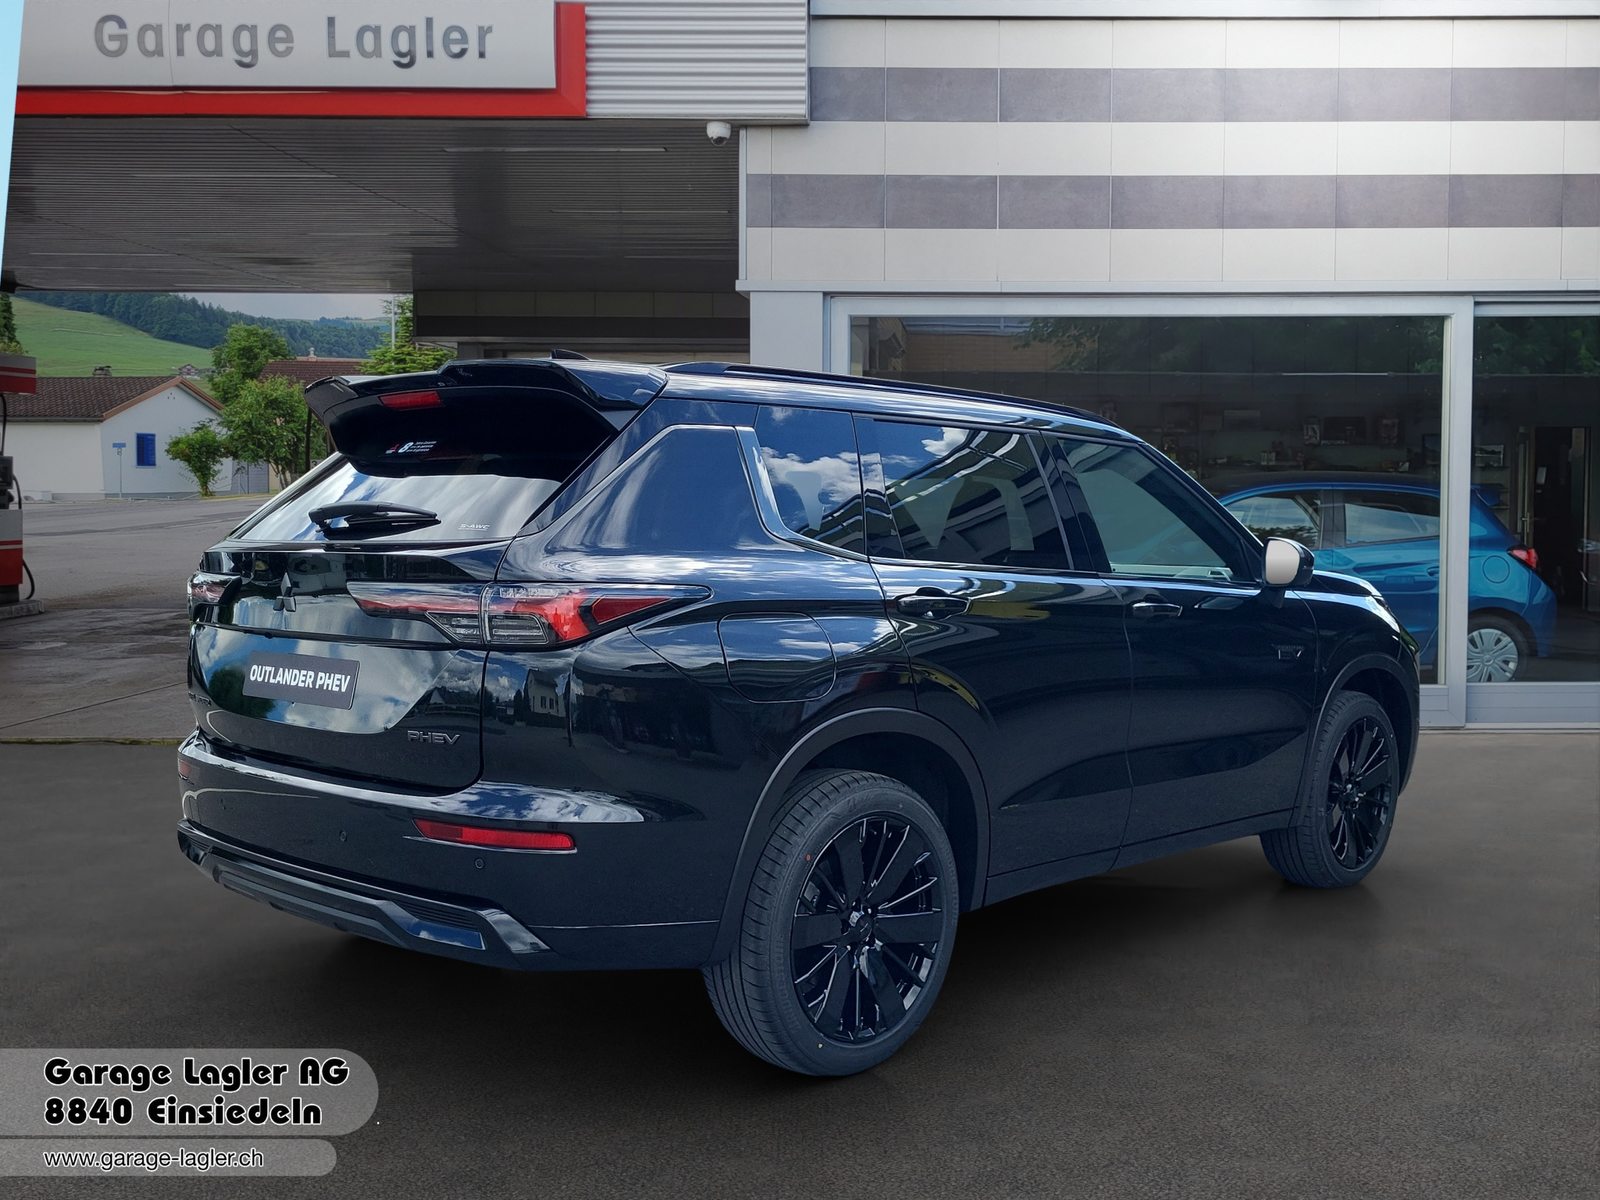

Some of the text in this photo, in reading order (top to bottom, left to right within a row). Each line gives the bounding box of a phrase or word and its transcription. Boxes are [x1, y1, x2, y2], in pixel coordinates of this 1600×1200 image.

[94, 14, 494, 70] Garage Lagler
[249, 664, 351, 693] OUTLANDER PHEV
[407, 730, 461, 745] PHEV
